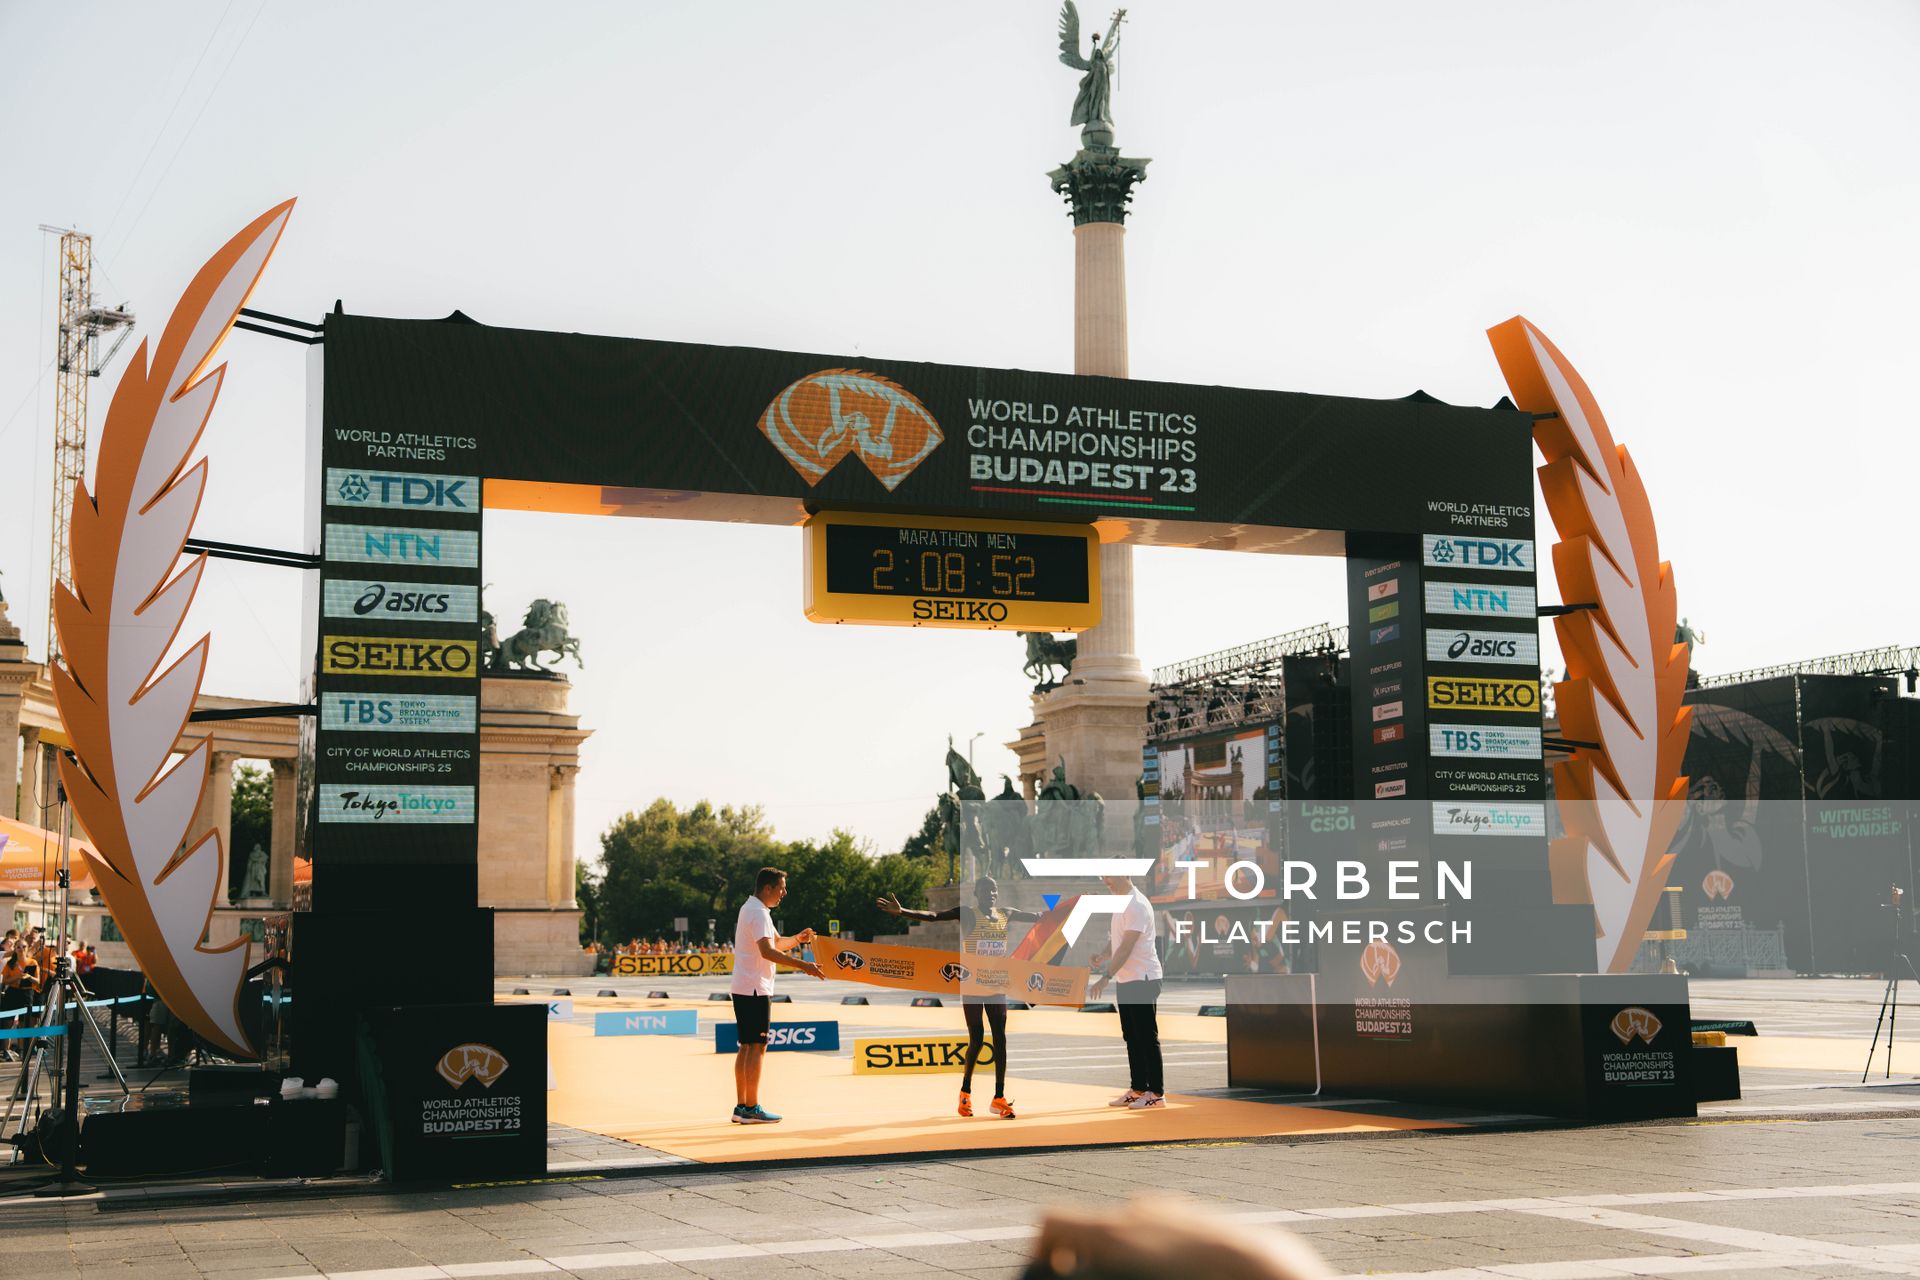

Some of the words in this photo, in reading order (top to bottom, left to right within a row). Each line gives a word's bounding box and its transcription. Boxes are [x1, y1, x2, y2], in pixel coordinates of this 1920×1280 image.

[968, 398, 1059, 425] WORLD
[1066, 406, 1196, 435] ATHLETICS
[335, 429, 391, 444] WORLD
[395, 433, 477, 449] ATHLETICS
[967, 425, 1196, 462] CHAMPIONSHIPS
[367, 446, 446, 461] PARTNERS
[970, 454, 1154, 490] BUDAPEST
[1159, 467, 1197, 492] 23
[369, 475, 466, 507] TDK
[1428, 501, 1469, 514] WORLD
[1471, 505, 1530, 517] ATHLETICS
[1451, 515, 1508, 527] PARTNERS
[364, 532, 441, 561] NTN
[899, 529, 978, 548] MARATHON
[988, 534, 1016, 549] MEN
[1454, 540, 1525, 567] TDK
[872, 549, 1035, 596] 2:08:52
[1453, 589, 1508, 612] NTN
[912, 600, 1007, 622] SEIKO
[330, 641, 471, 672] SEIKO
[1433, 681, 1535, 707] SEIKO
[339, 700, 393, 724] TBS
[399, 709, 460, 718] BROADCASTING
[399, 717, 430, 725] SYSTEM
[1442, 730, 1481, 751] TBS
[327, 748, 351, 757] CITY
[354, 748, 369, 757] OF
[373, 749, 411, 758] WORLD
[413, 749, 471, 759] ATHLETICS
[346, 763, 435, 772] CHAMPIONSHIPS
[438, 764, 452, 772] 25
[1435, 771, 1453, 779] CITY
[1455, 771, 1466, 779] OF
[1468, 771, 1496, 780] WORLD
[1497, 773, 1539, 781] ATHLETICS
[1449, 783, 1514, 793] CHAMPIONSHIPS
[1515, 785, 1526, 793] 25
[1820, 807, 1891, 824] WITNESS
[1829, 821, 1902, 838] WONDER
[619, 956, 704, 973] SEIKO
[870, 967, 905, 975] BUDAPEST
[1355, 998, 1376, 1006] WORLD
[1377, 998, 1410, 1007] ATHLETICS
[1355, 1009, 1411, 1020] CHAMPIONSHIPS
[626, 1016, 667, 1030] NTN
[1356, 1021, 1400, 1033] BUDAPEST
[1402, 1023, 1412, 1034] 23
[865, 1041, 996, 1068] SEIKO
[1603, 1053, 1631, 1061] WORLD
[1633, 1052, 1673, 1060] ATHLETICS
[1603, 1061, 1674, 1070] CHAMPIONSHIPS
[1605, 1071, 1661, 1081] BUDAPEST
[1662, 1071, 1675, 1079] 23
[423, 1099, 461, 1109] WORLD
[464, 1097, 520, 1107] ATHLETICS
[422, 1107, 520, 1120] CHAMPIONSHIPS
[424, 1119, 501, 1133] BUDAPEST
[504, 1118, 520, 1129] 23
